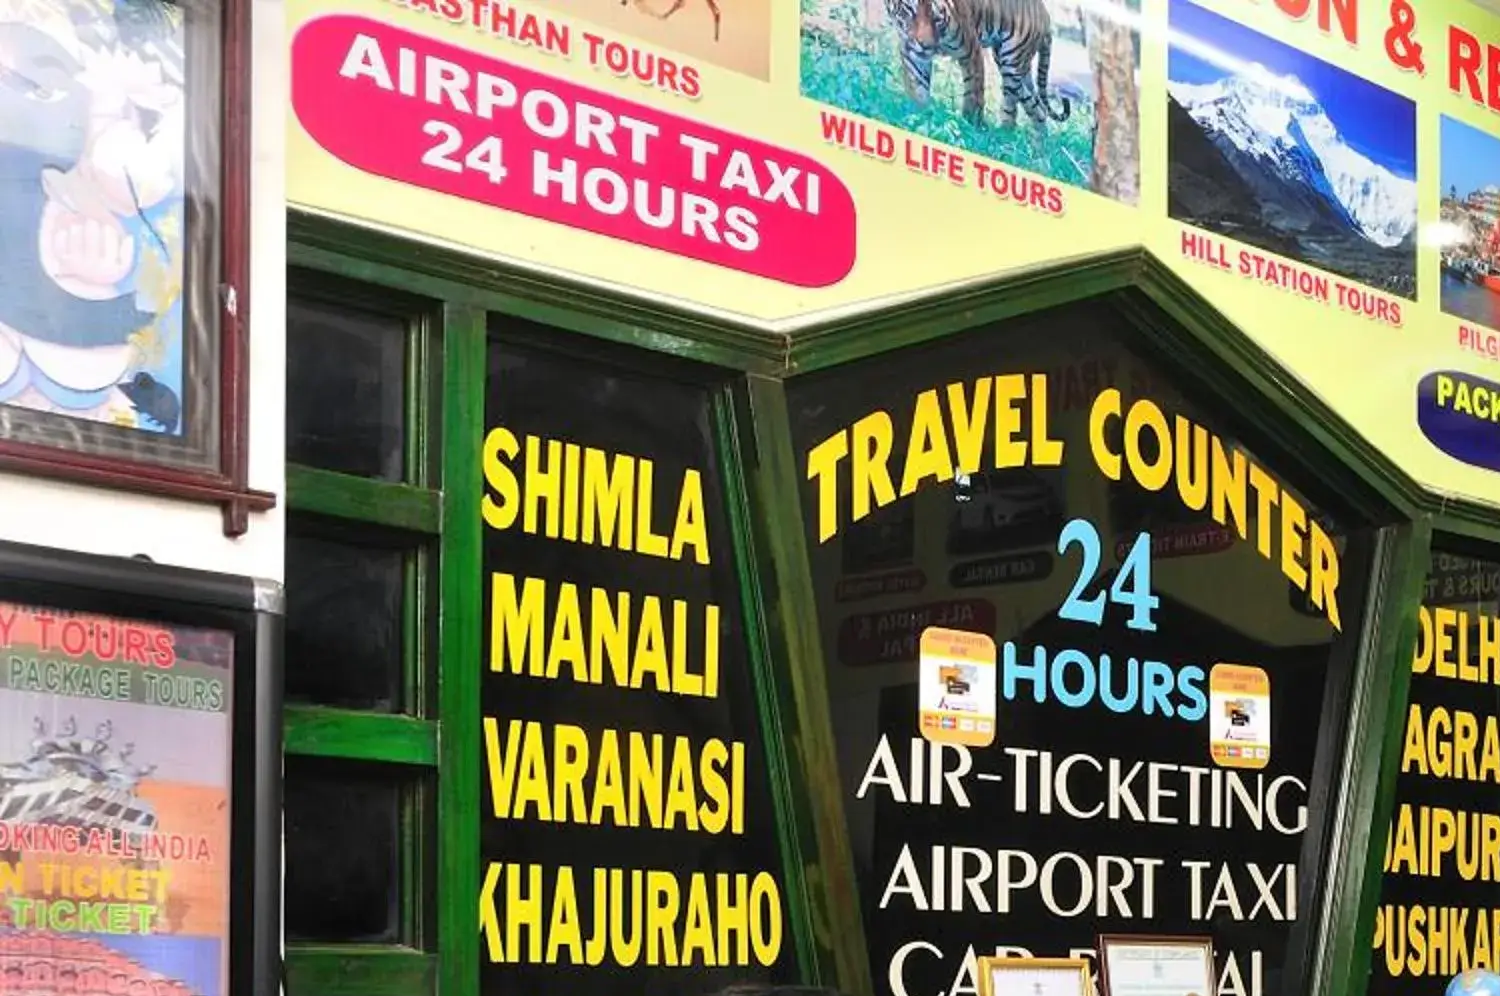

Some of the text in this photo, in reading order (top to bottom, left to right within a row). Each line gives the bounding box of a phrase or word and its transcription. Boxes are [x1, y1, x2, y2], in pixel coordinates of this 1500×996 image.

[583, 32, 700, 96] TOURS
[1384, 0, 1425, 74] &
[340, 34, 821, 215] AIRPORT TAXI
[821, 112, 1063, 213] WILD LIFE TOURS
[420, 119, 760, 252] 24 HOURS
[1181, 230, 1402, 326] HILL STATION TOURS
[481, 427, 710, 565] SHIMLA
[807, 373, 1341, 633] TRAVEL COUNTER
[1058, 518, 1159, 631] 24
[9, 655, 224, 711] PACKAGE TOURS
[34, 615, 176, 669] TOURS
[492, 573, 719, 698] MANALI
[1003, 640, 1207, 721] HOURS
[484, 717, 745, 835] VARANASI
[857, 734, 1308, 836] AIR-TICKETING
[39, 862, 173, 902] TICKET
[87, 829, 135, 859] ALL
[143, 832, 212, 862] INDIA
[880, 844, 1296, 921] AIRPORT TAXI
[11, 897, 157, 935] TICKET
